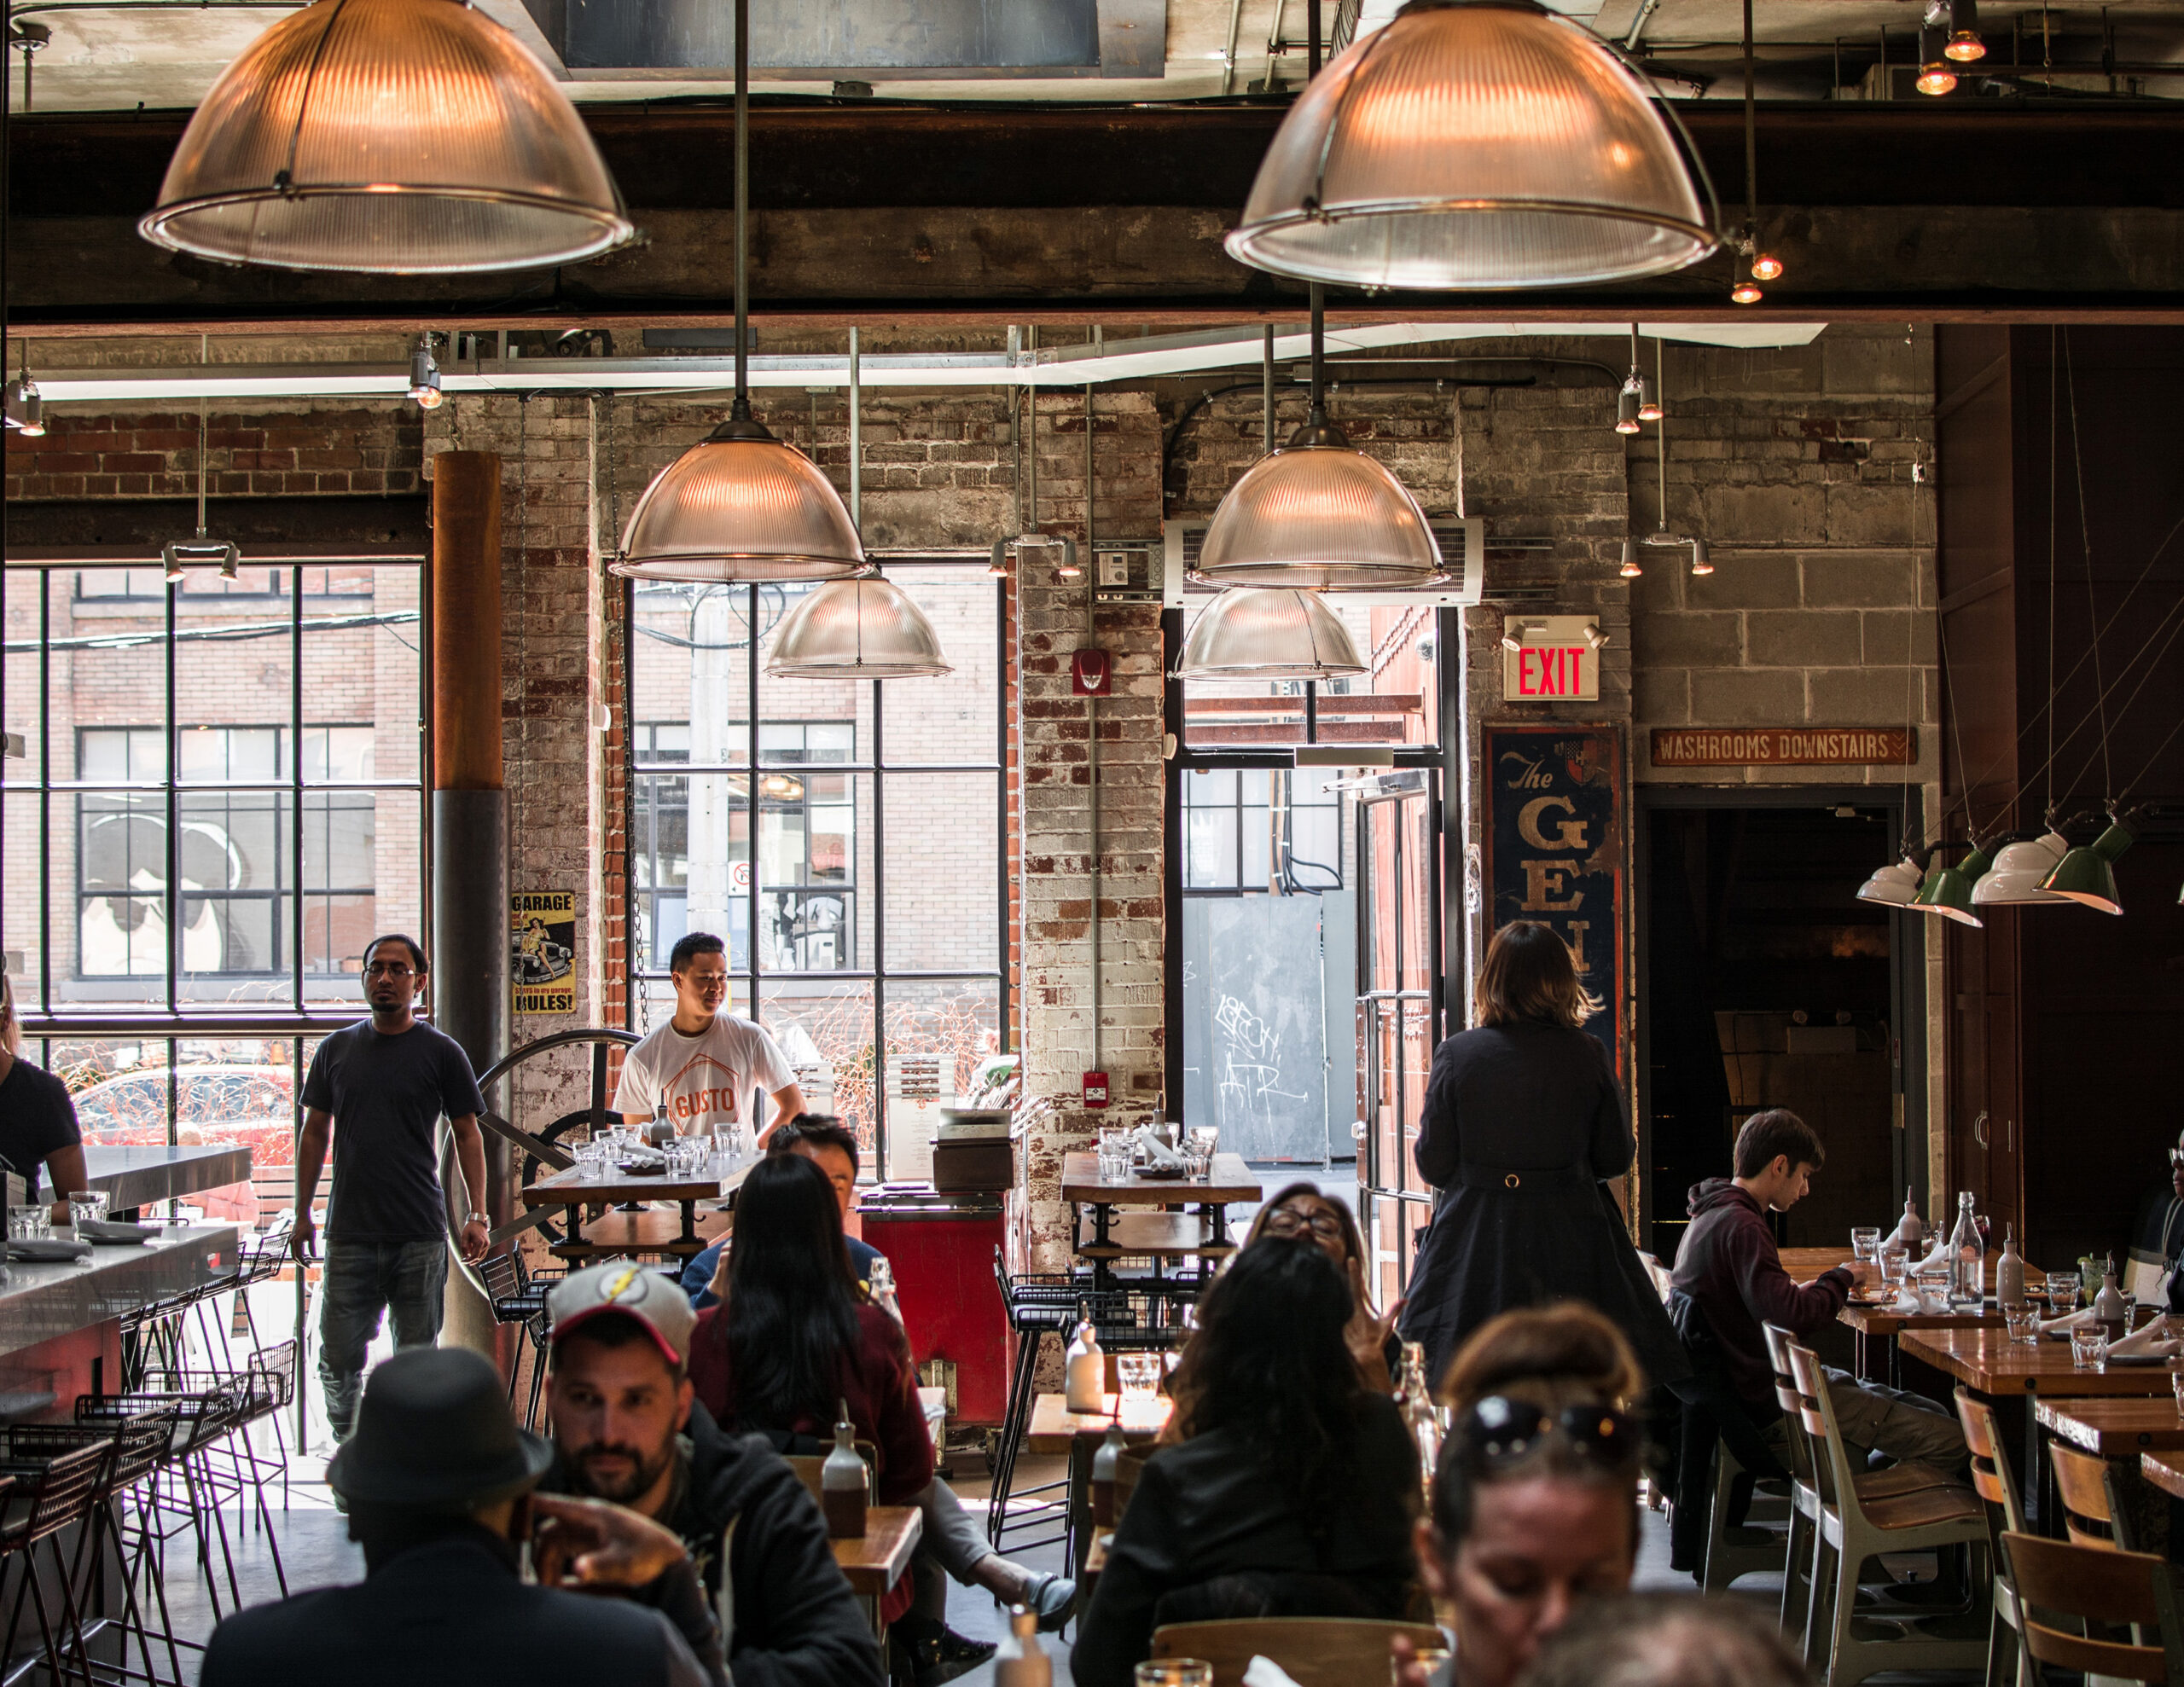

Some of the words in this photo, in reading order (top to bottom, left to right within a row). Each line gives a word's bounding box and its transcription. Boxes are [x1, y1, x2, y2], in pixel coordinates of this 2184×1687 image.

[1519, 647, 1584, 695] EXIT
[1659, 734, 1771, 760] WASHROOMS
[1779, 733, 1889, 759] DOWNSTAIRS
[1499, 751, 1554, 789] The
[512, 895, 572, 912] GARAGE
[515, 994, 572, 1012] RULES!
[675, 1087, 735, 1118] GUSTO
